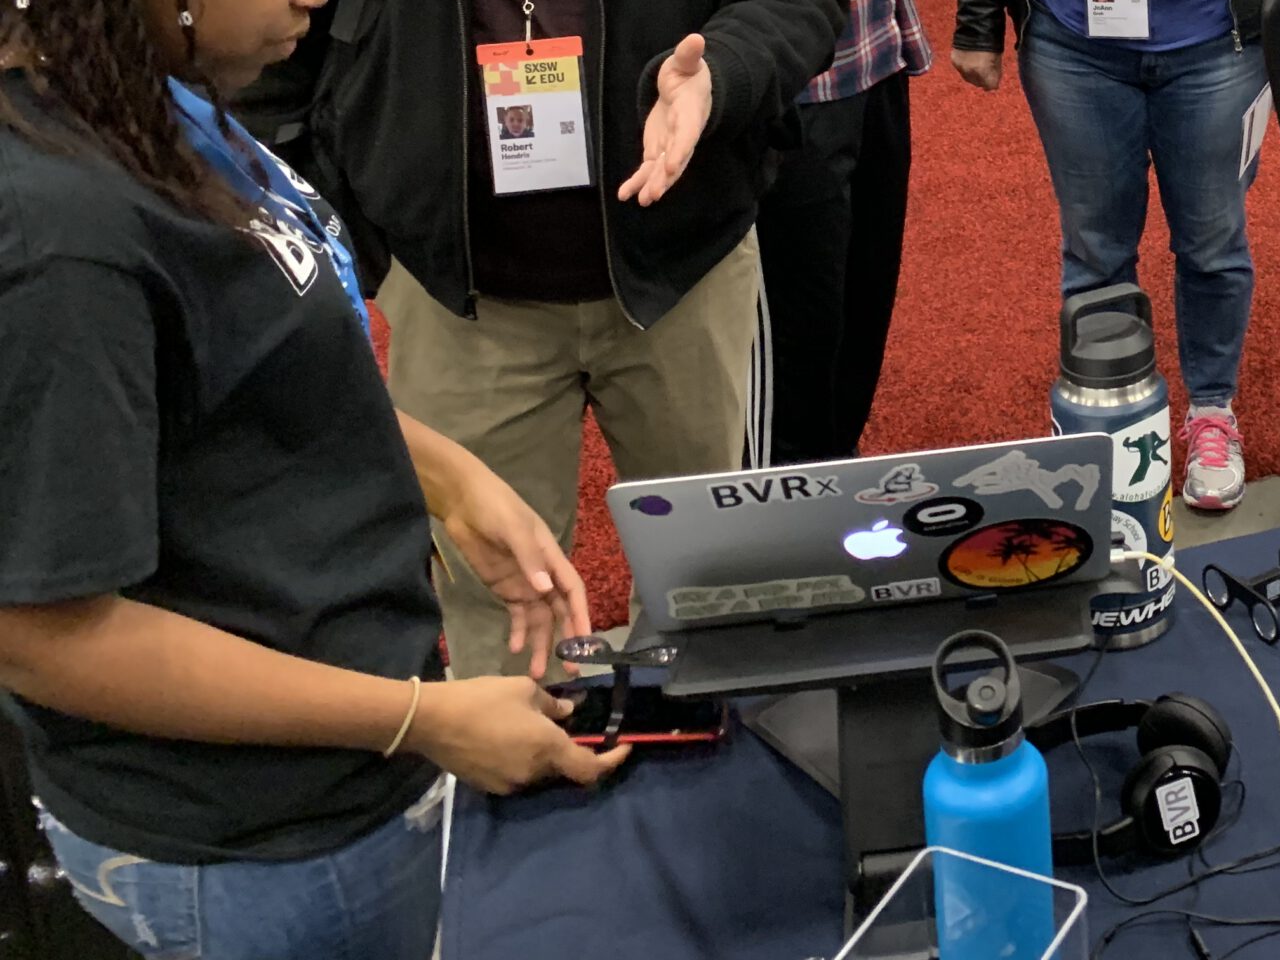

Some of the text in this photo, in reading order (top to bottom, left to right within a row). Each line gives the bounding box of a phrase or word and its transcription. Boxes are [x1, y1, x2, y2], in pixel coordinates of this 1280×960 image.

[524, 61, 558, 74] SXSW
[540, 72, 565, 84] EDU
[500, 142, 534, 153] Robert
[1122, 517, 1142, 542] School
[874, 581, 934, 600] BVR
[1164, 785, 1196, 841] BVR
